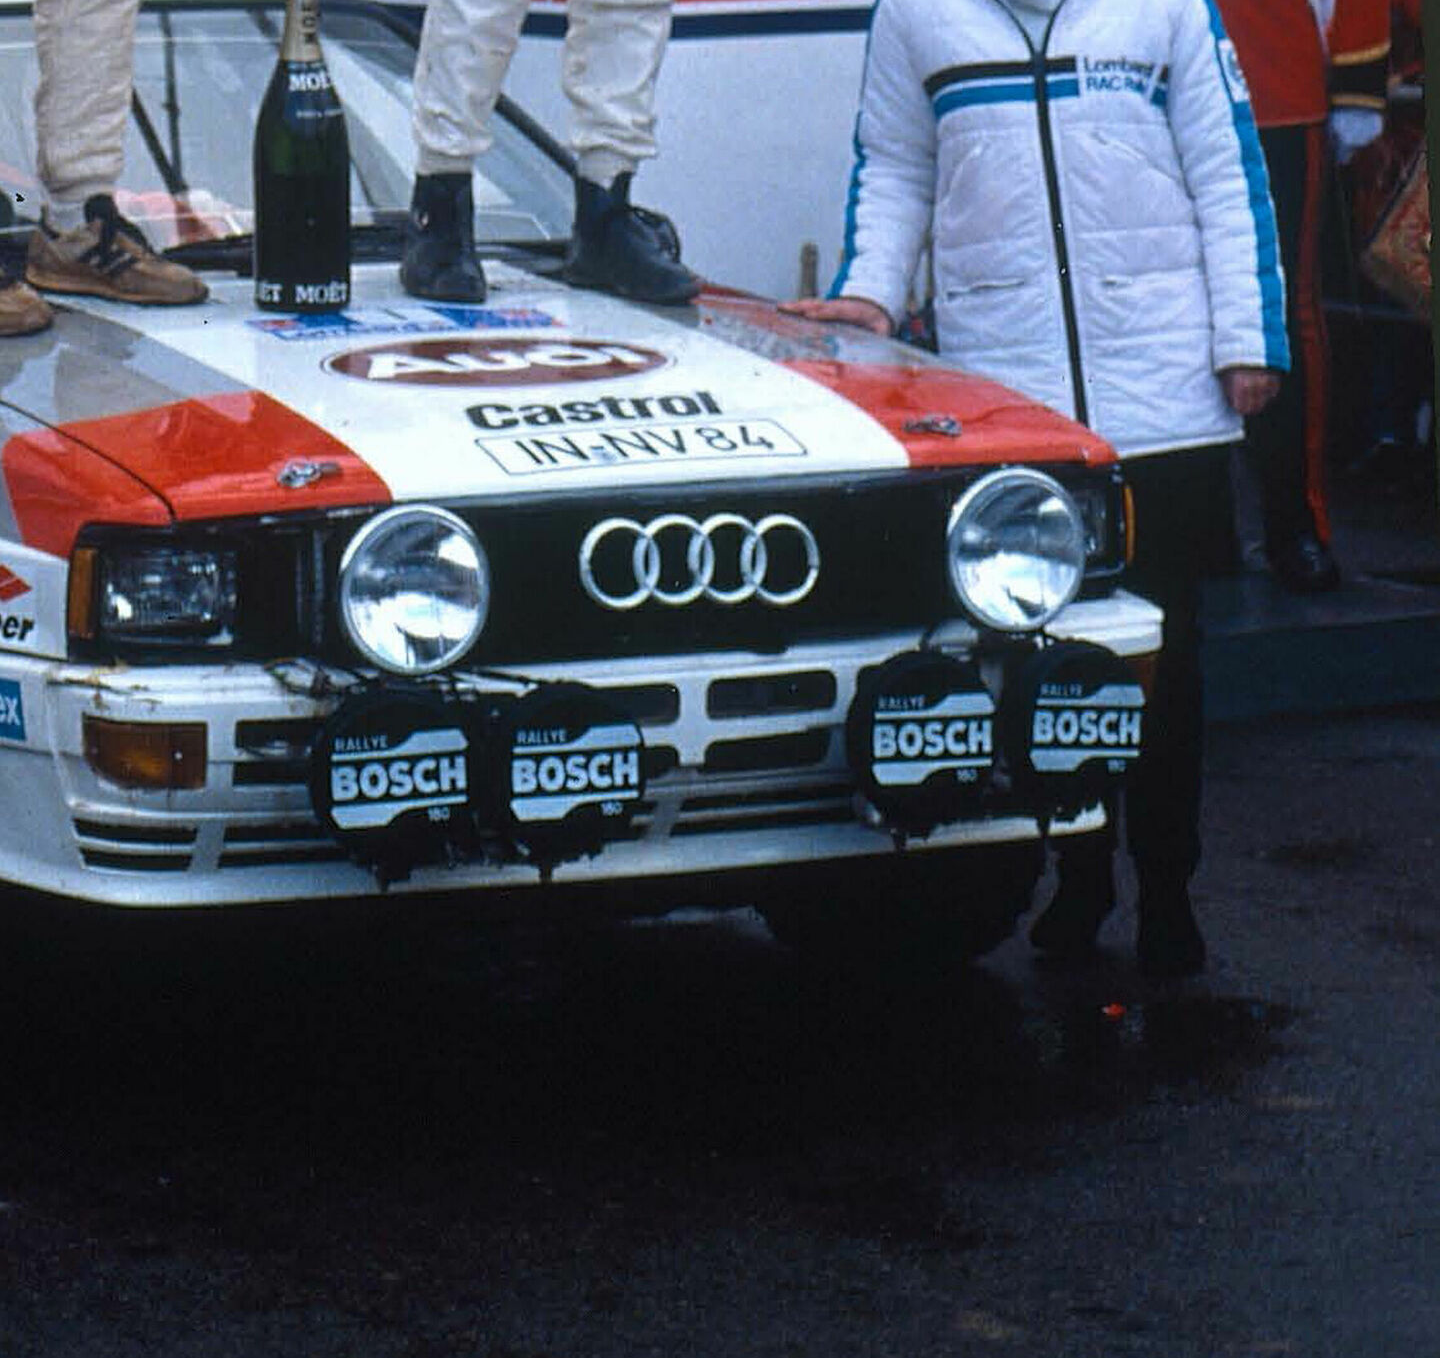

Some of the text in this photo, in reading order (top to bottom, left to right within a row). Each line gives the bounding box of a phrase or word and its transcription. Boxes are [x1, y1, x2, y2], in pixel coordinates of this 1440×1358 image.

[464, 390, 723, 431] Castrol
[873, 719, 993, 759] BOSCH
[1033, 709, 1141, 745] BOSCH
[331, 754, 467, 802] BOSCH
[511, 750, 639, 795] BOSCH
